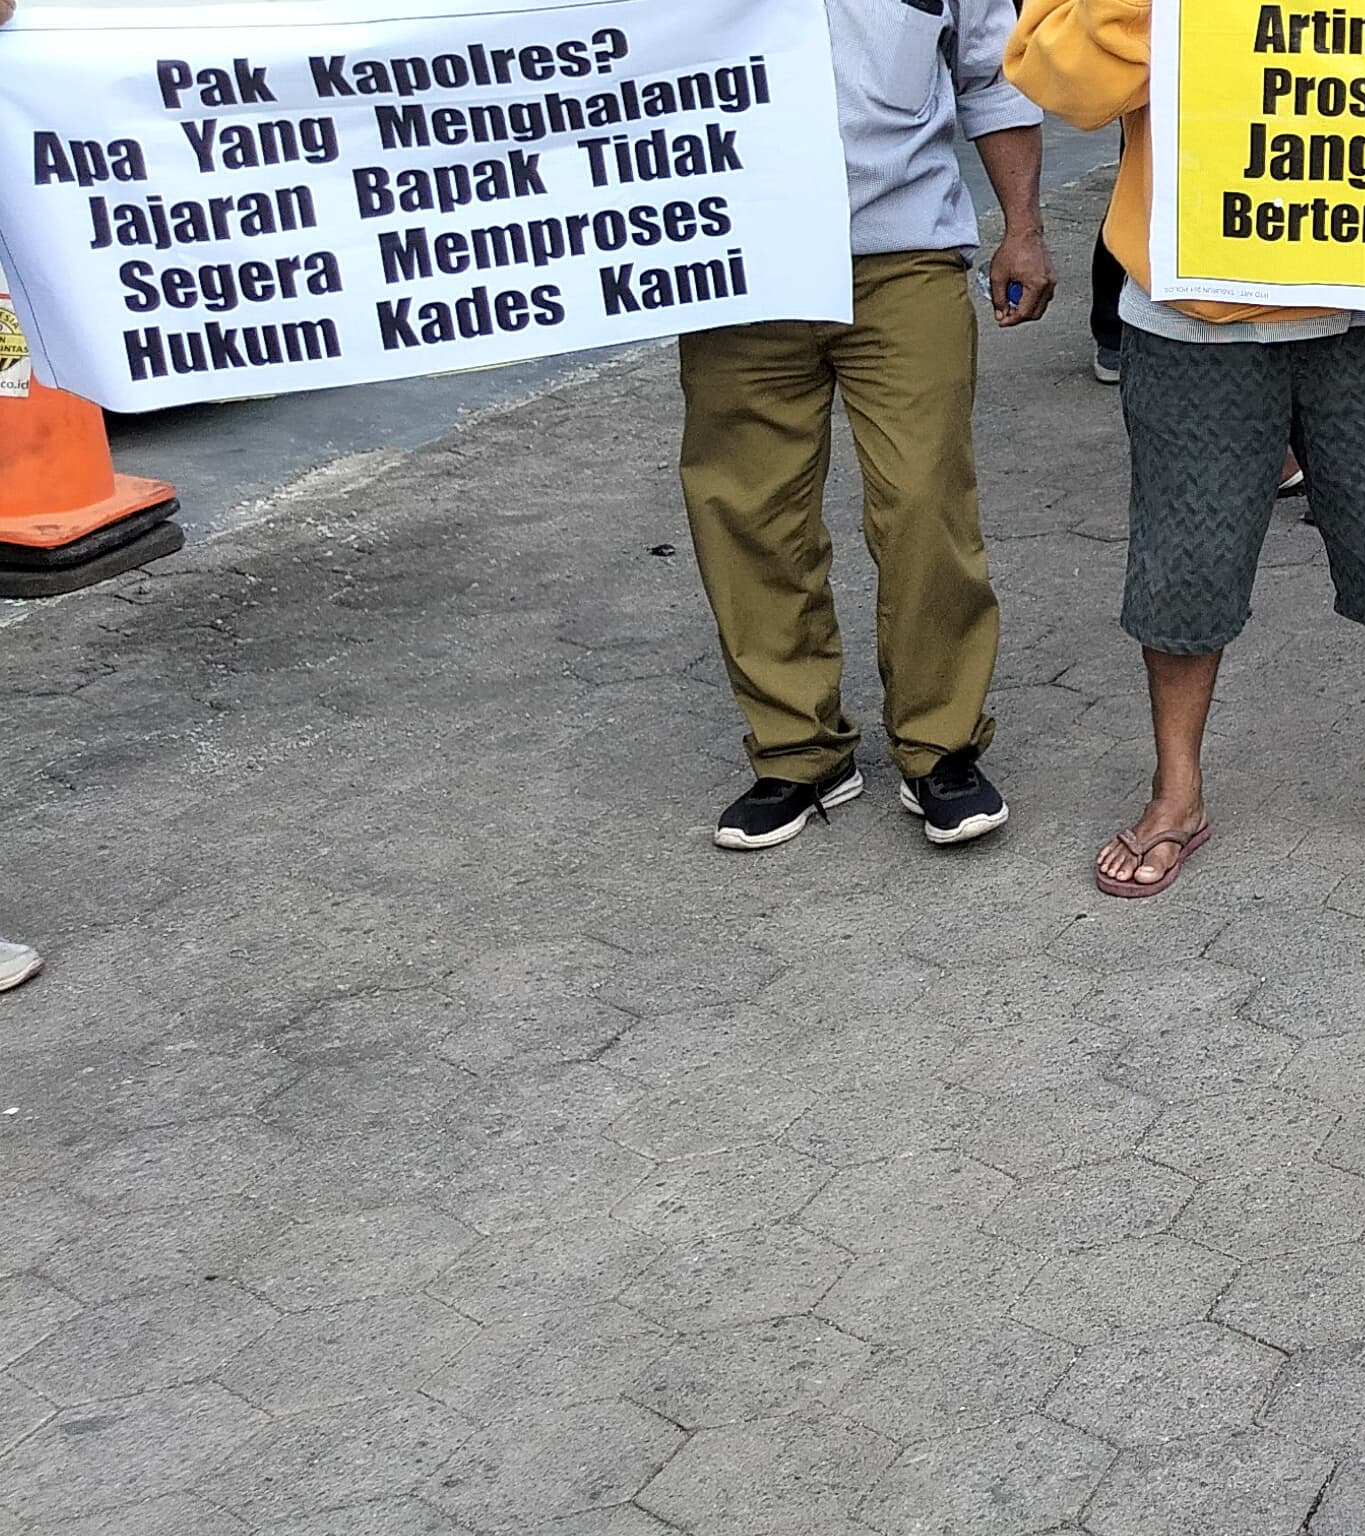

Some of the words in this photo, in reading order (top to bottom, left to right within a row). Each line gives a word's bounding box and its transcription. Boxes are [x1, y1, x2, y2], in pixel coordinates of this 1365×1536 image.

[33, 131, 147, 187] Apa
[180, 117, 339, 173] Yang
[375, 55, 771, 150] Menghalangi
[157, 58, 277, 109] Pak
[316, 28, 628, 100] Kapolres?
[88, 185, 317, 250] Jajaran
[352, 149, 547, 219] Bapak
[576, 123, 743, 188] Tidak
[119, 251, 343, 313] Segera
[380, 195, 732, 284] Memproses
[123, 318, 341, 381] Hukum
[375, 284, 565, 350] Kades
[599, 247, 748, 316] Kami
